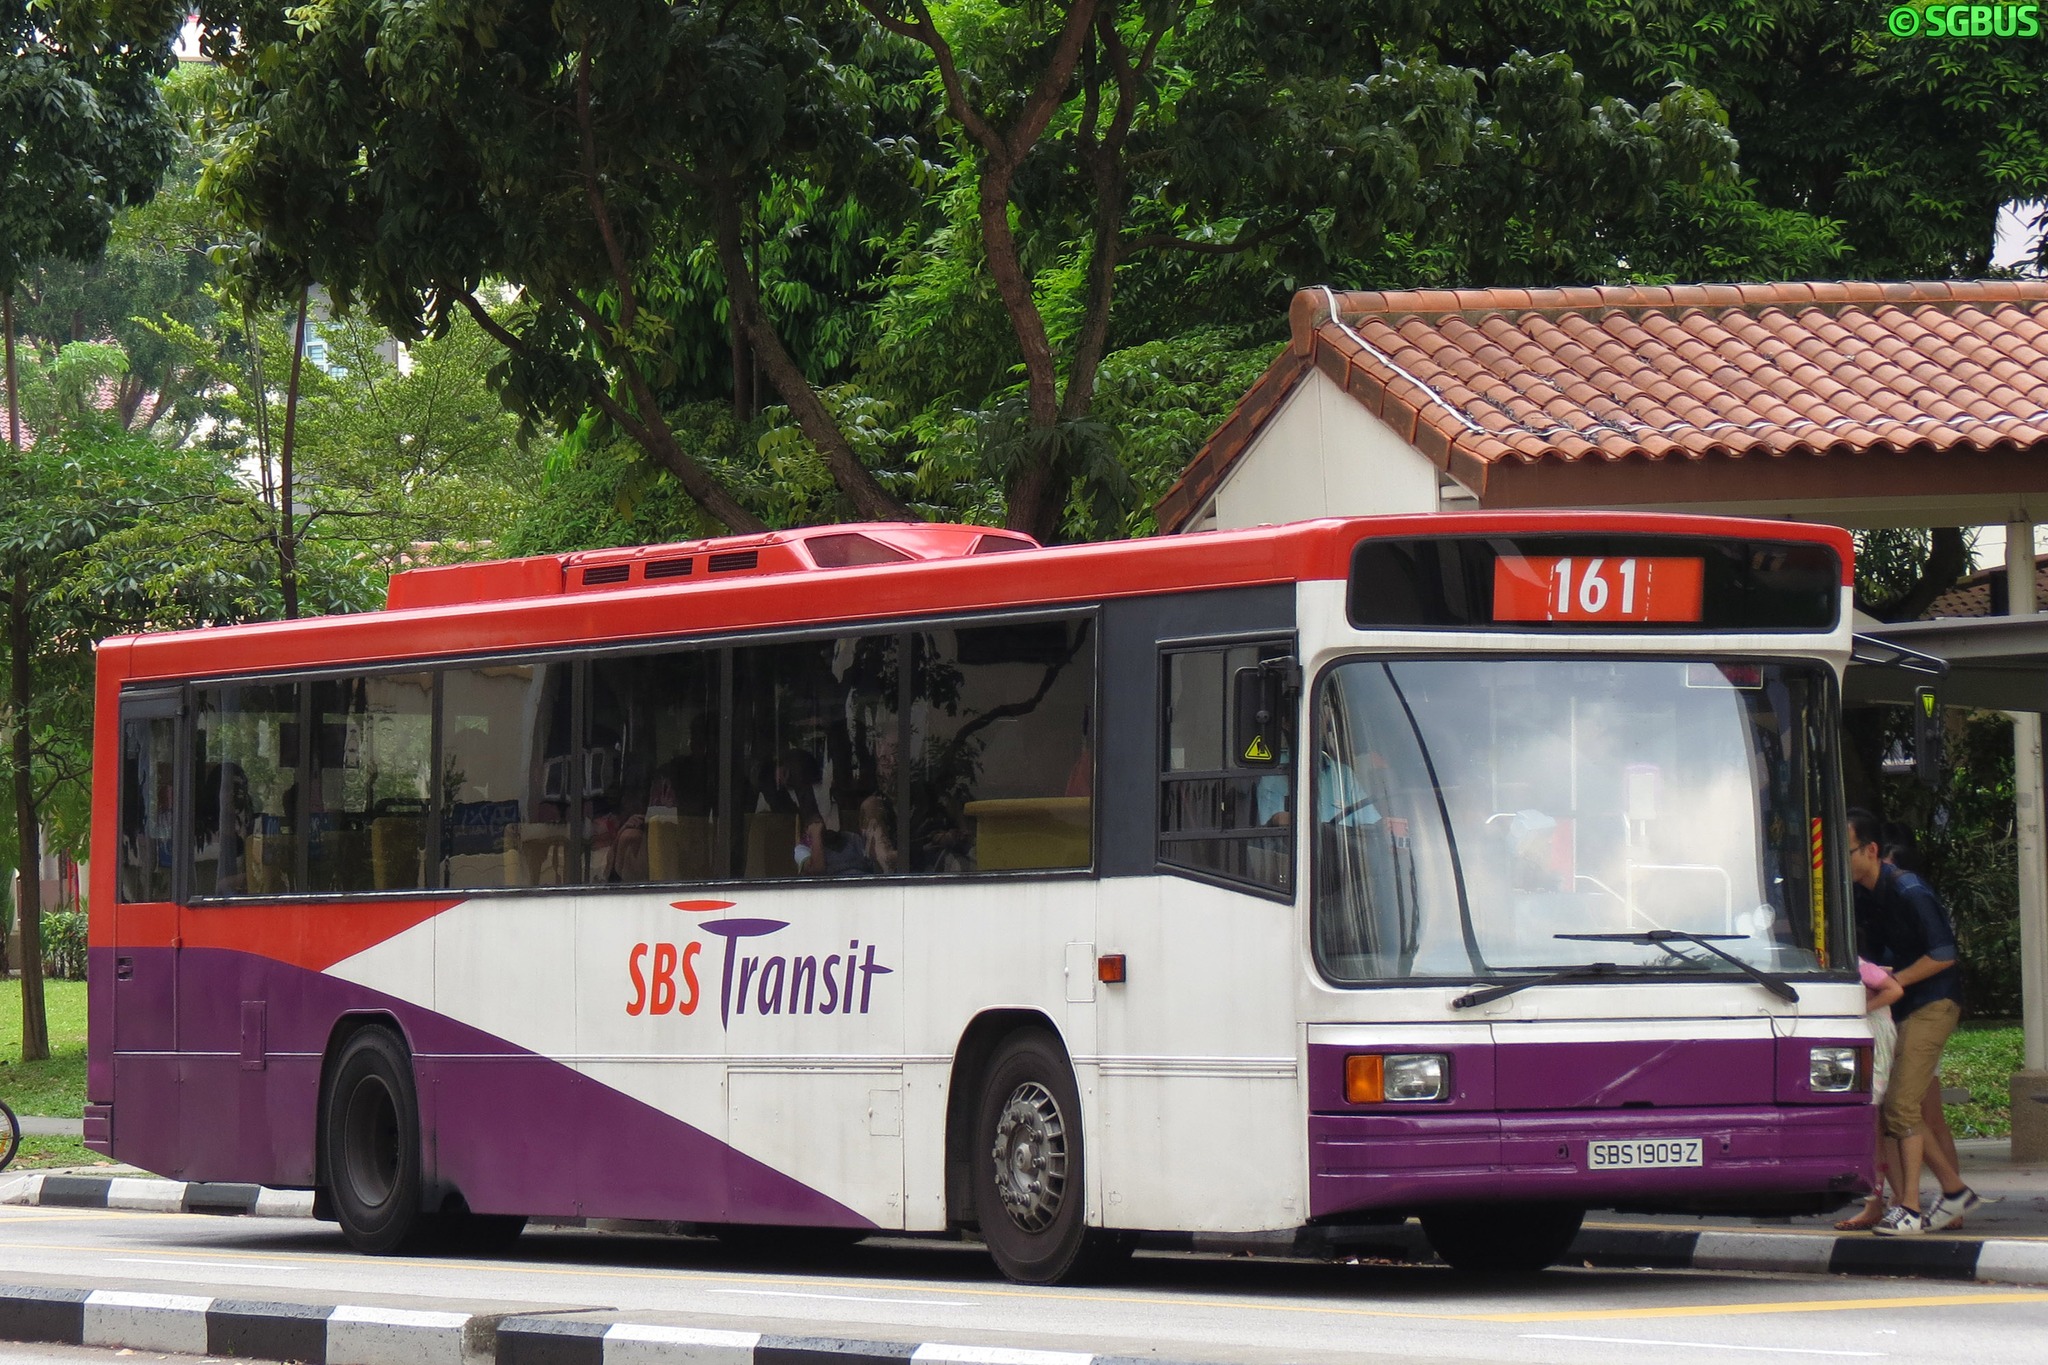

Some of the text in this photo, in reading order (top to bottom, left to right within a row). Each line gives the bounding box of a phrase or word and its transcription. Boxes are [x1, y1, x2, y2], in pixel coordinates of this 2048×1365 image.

[1555, 558, 1636, 614] 161
[626, 918, 894, 1033] SBS Transit
